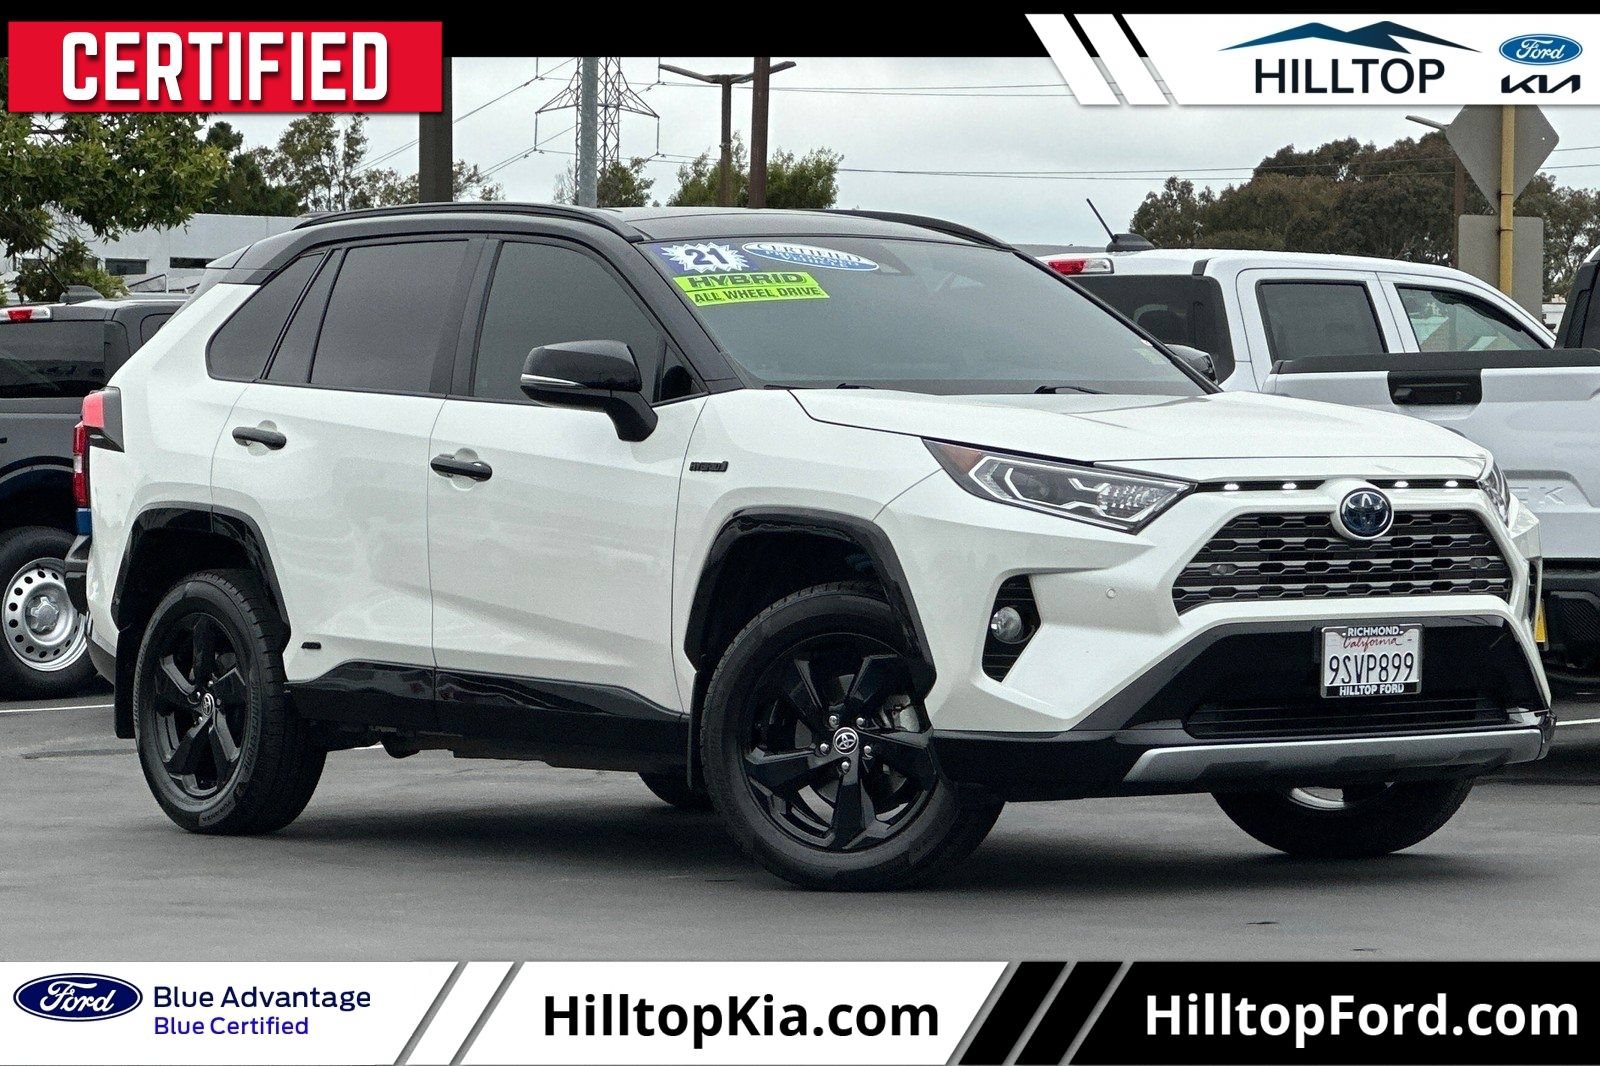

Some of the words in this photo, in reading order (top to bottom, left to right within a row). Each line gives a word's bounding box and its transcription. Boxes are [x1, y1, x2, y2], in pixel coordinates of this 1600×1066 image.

[685, 248, 728, 265] 21
[690, 273, 806, 288] HYBRID
[693, 290, 723, 303] ALL
[726, 288, 775, 300] WHEEL
[778, 286, 821, 299] DRIVE
[1347, 626, 1400, 637] RICHMOND
[1343, 636, 1403, 652] California
[1329, 652, 1415, 685] 9SVP899
[1339, 685, 1378, 696] HILLTOP
[1379, 683, 1405, 694] FORD
